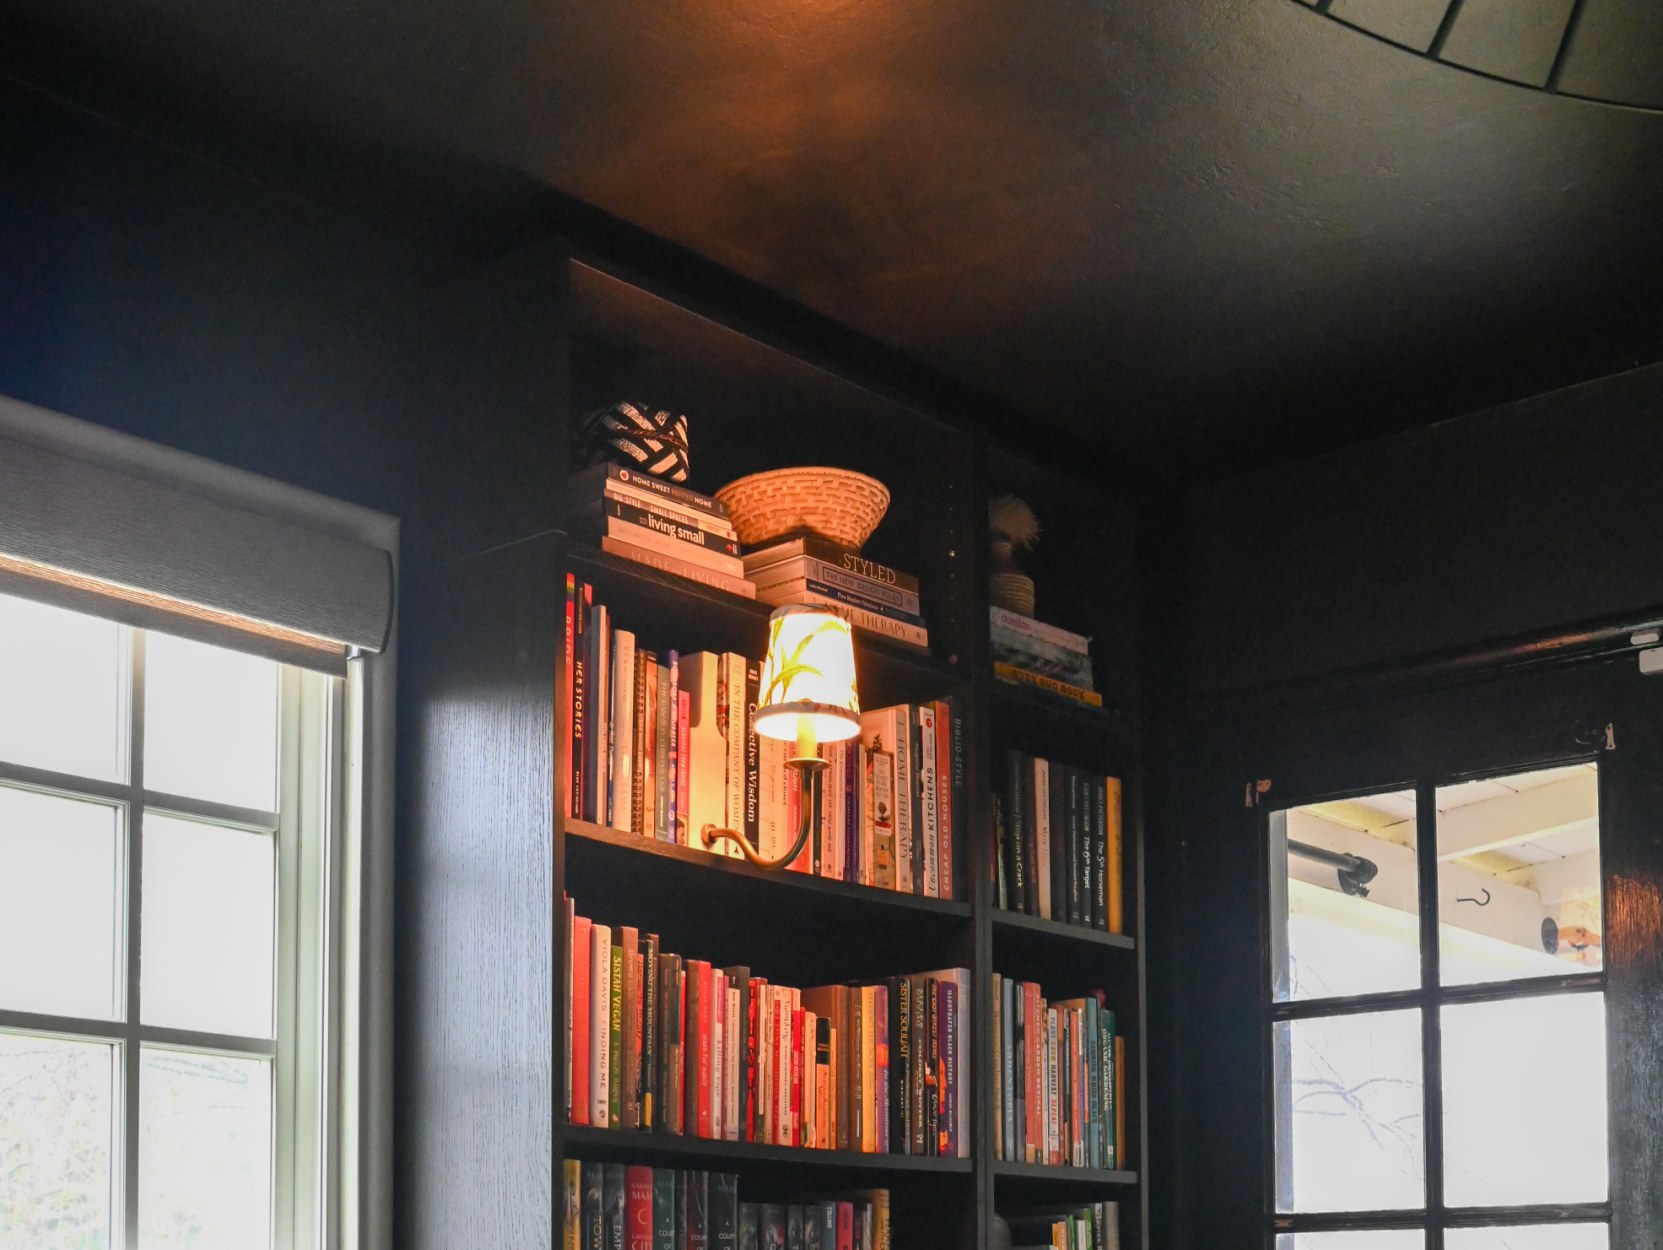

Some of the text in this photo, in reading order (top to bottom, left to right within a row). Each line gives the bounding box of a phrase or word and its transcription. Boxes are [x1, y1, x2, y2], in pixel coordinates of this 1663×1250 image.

[648, 514, 705, 545] living small
[683, 567, 730, 591] LIVING
[843, 552, 897, 585] STYLED
[575, 687, 583, 740] STORIES
[733, 699, 741, 722] THE
[733, 723, 741, 775] COMPANY
[747, 702, 759, 822] Coective Wisdom
[733, 776, 741, 792] OF
[926, 767, 935, 830] KITCHENS
[941, 774, 951, 892] CHEAP OLD HOUSES
[1016, 863, 1024, 888] Crack
[1083, 866, 1091, 889] Target
[1097, 869, 1105, 907] Horseman
[601, 939, 609, 974] VIOLA
[612, 955, 622, 993] SISTAH
[646, 947, 654, 985] MOVING
[612, 996, 622, 1032] VEGAN
[900, 982, 908, 1014] SISTER
[600, 1021, 608, 1069] FINDING
